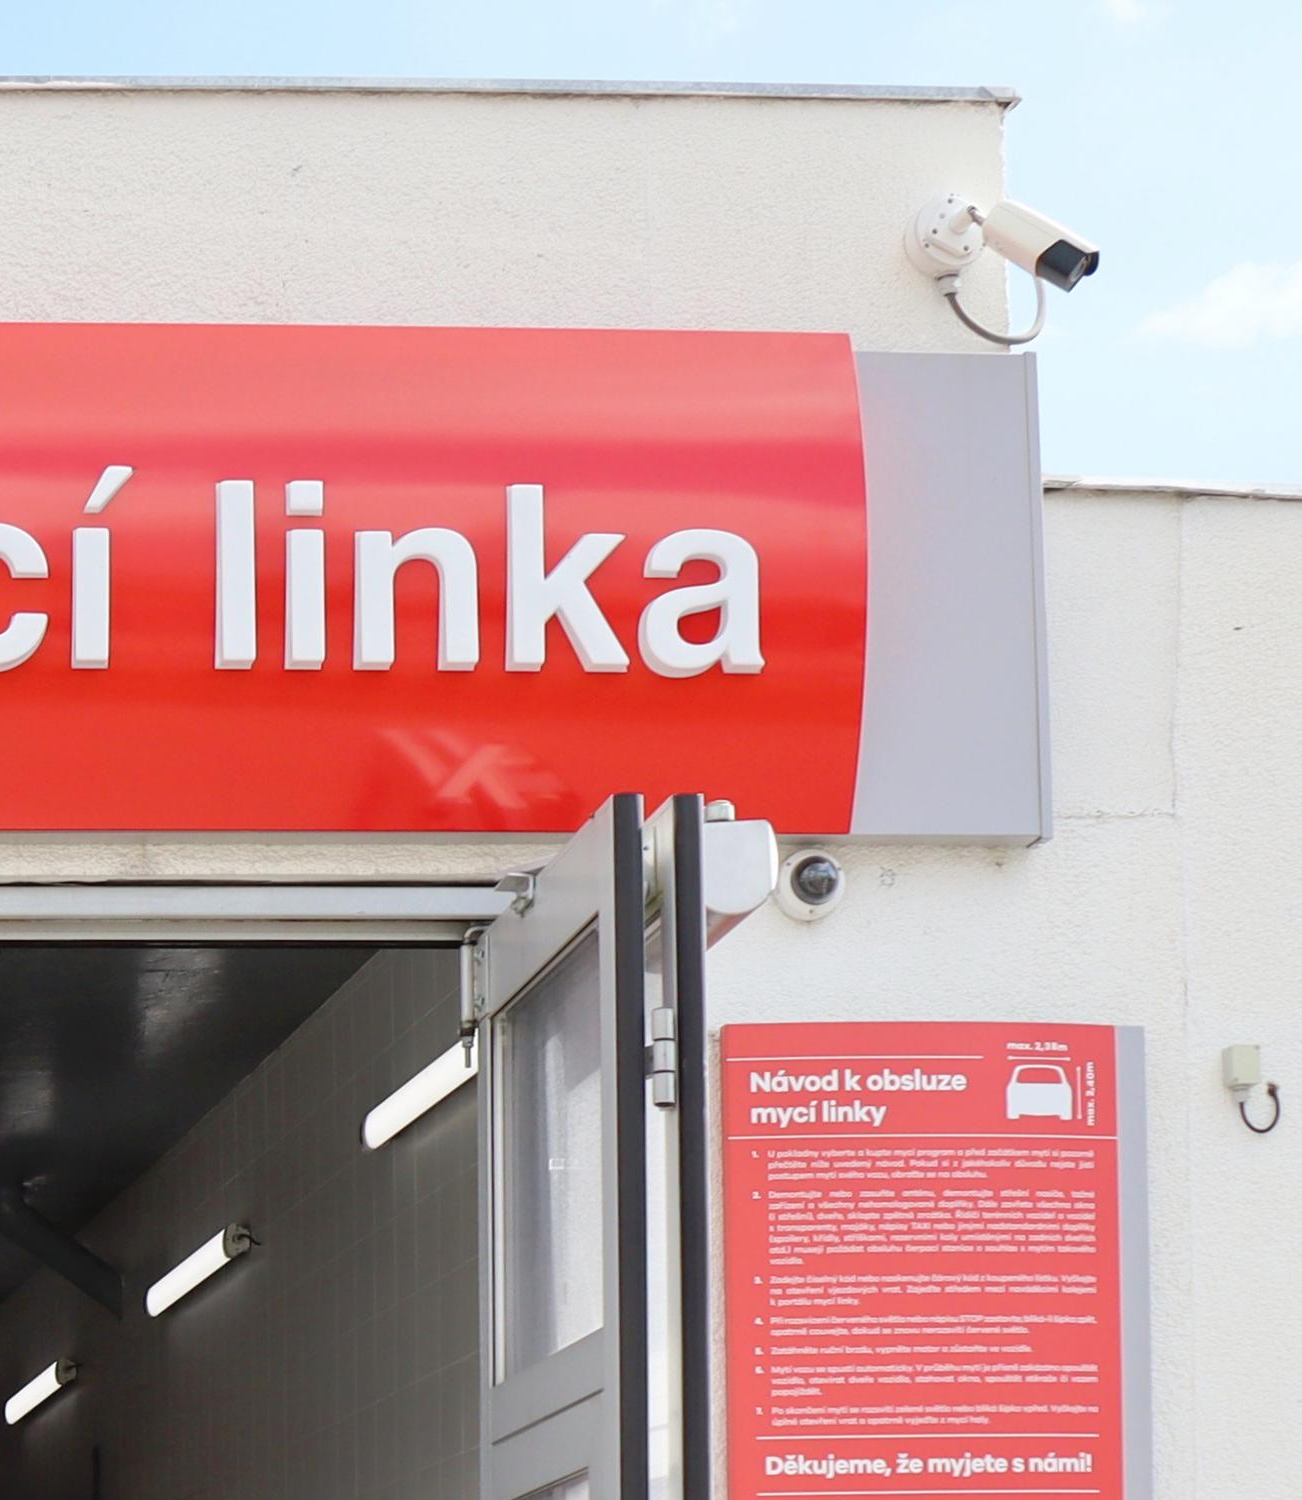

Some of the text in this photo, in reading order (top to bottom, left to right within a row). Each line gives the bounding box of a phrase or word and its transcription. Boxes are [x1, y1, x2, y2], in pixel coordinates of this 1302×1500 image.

[214, 480, 766, 677] linka
[750, 1068, 967, 1093] Návod k obsluze
[750, 1099, 887, 1128] mycí linky
[752, 1191, 761, 1199] 2.
[765, 1452, 1093, 1478] Děkujeme, že myjete s námi!
